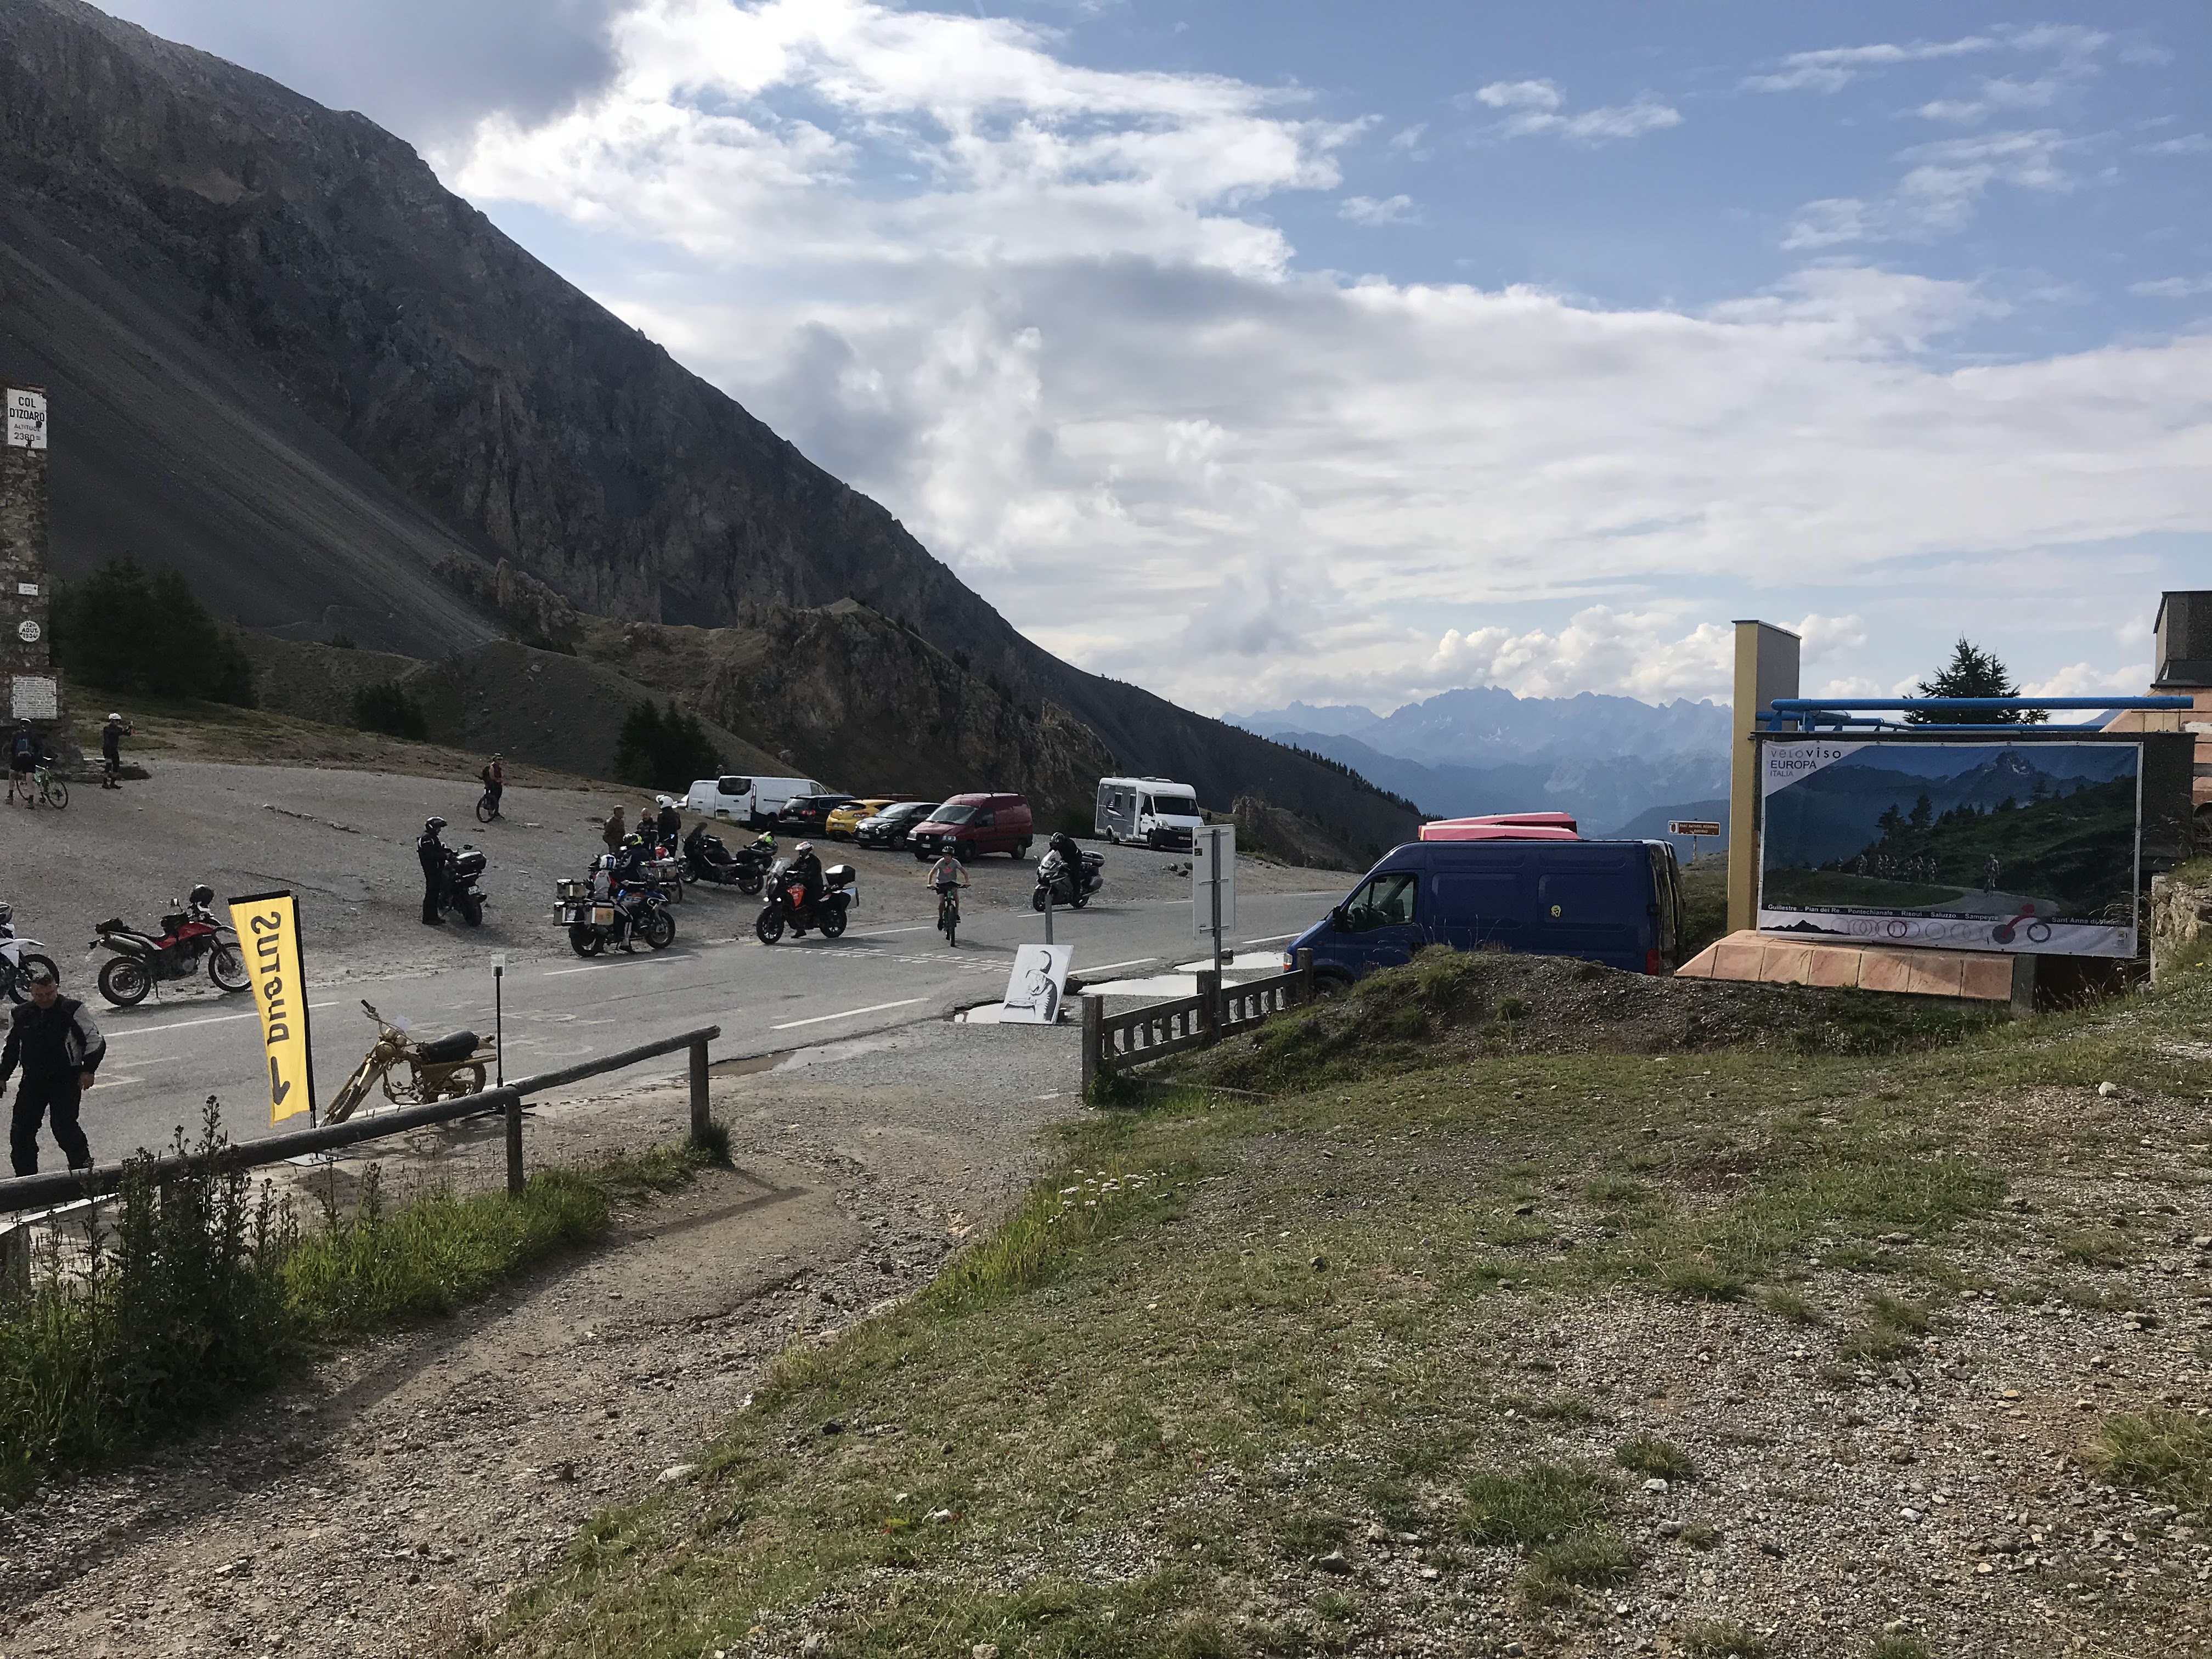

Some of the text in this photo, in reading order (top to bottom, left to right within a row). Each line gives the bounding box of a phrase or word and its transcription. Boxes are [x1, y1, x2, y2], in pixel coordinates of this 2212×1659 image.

[18, 397, 36, 408] COL
[9, 408, 45, 422] D'IZOARD
[14, 432, 35, 441] 2360
[1771, 760, 1817, 769] EUROPA
[1965, 913, 1999, 921] Sampeyre
